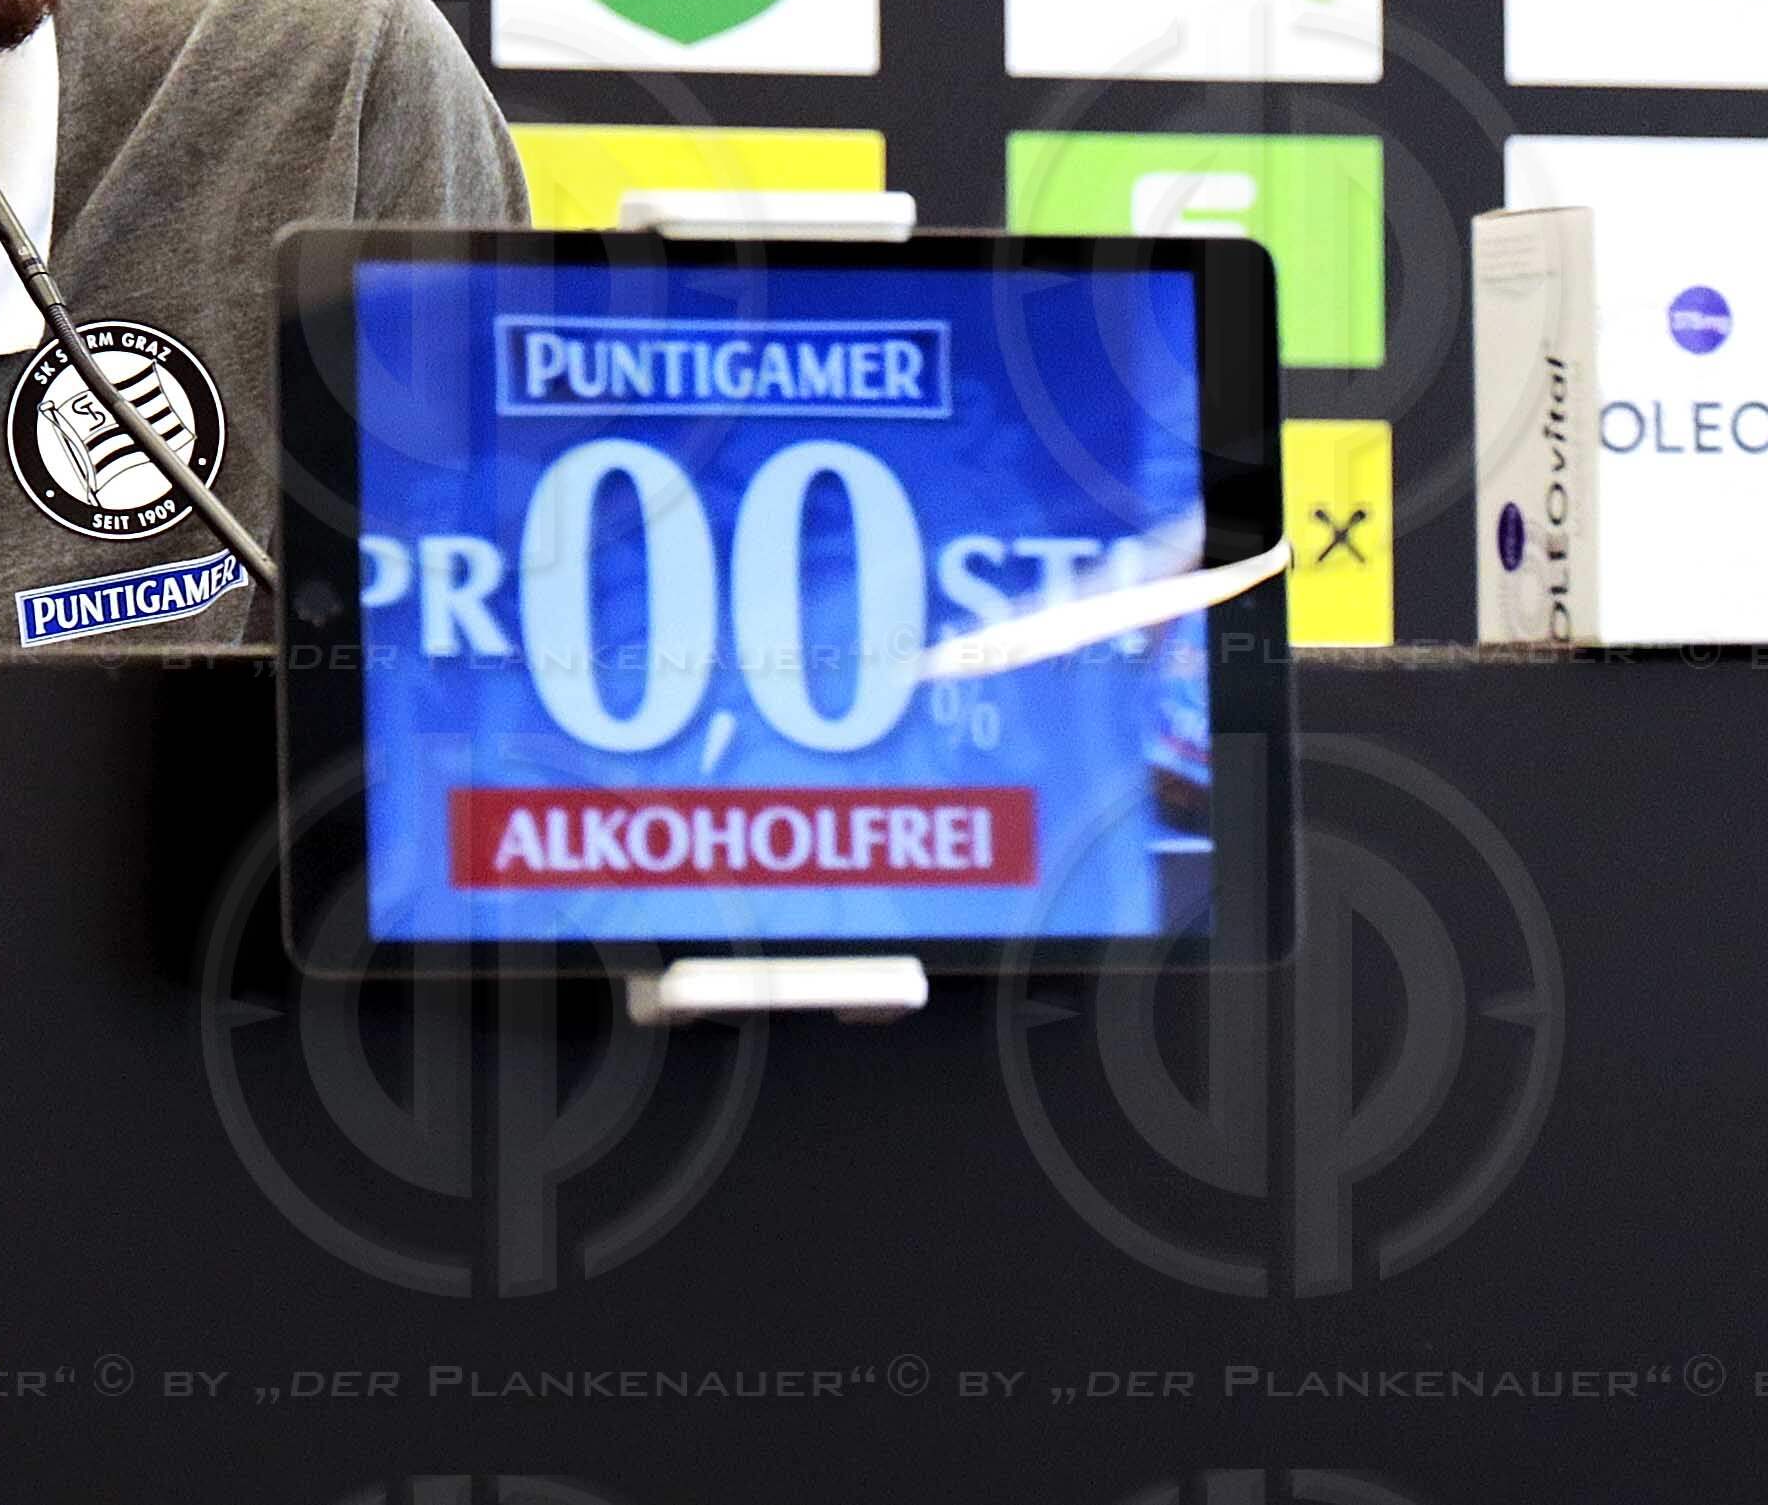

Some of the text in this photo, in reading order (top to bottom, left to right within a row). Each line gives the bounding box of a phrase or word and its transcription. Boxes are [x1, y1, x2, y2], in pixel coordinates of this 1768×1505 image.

[34, 333, 172, 385] SK SRM GRAZ
[526, 333, 926, 400] PUNTIGAMER
[92, 499, 176, 529] SEIT 1909
[31, 554, 237, 635] PUNTIGAMER
[495, 806, 993, 874] ALKOHOLFREI
